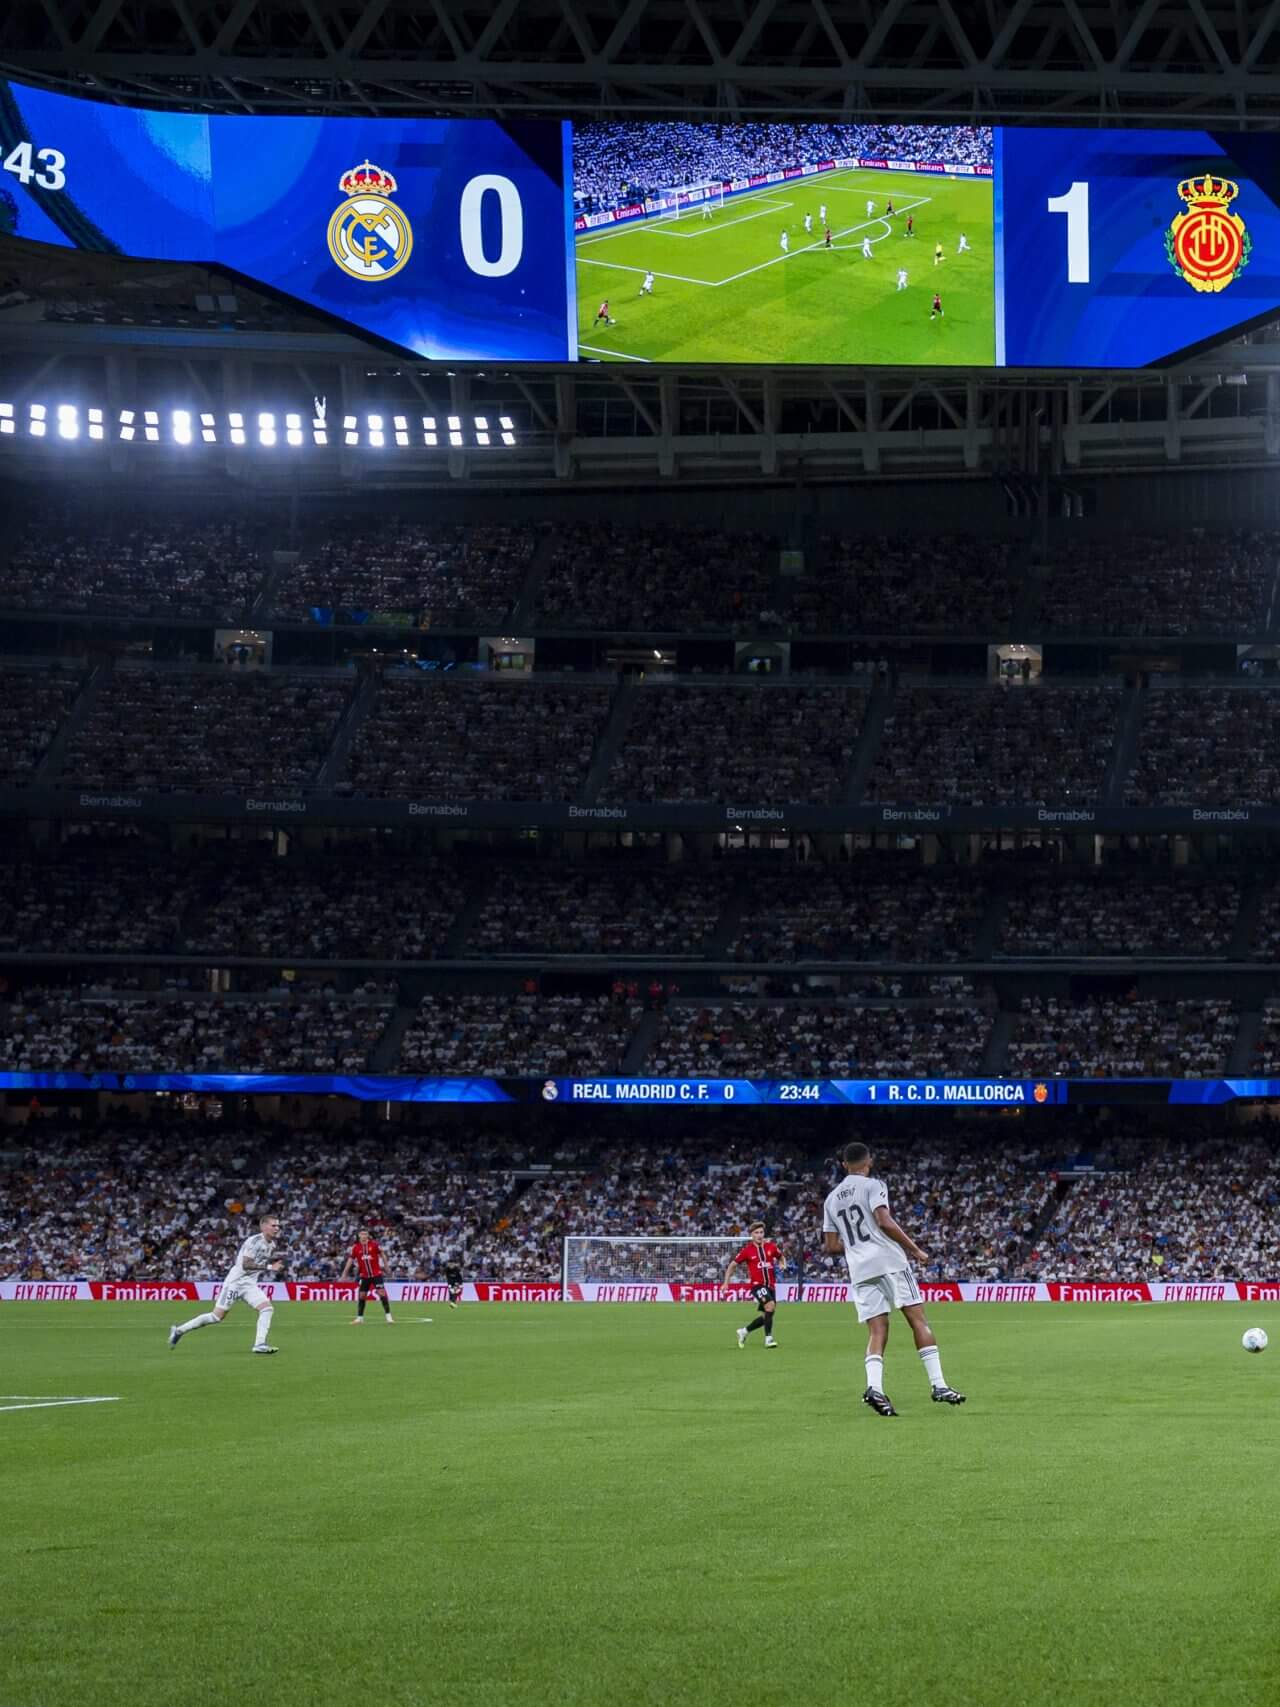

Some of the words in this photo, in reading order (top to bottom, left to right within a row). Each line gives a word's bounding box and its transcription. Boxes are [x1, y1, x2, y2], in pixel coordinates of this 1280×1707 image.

[0, 141, 66, 190] 43
[460, 174, 523, 278] 0
[1048, 181, 1090, 283] 1
[246, 799, 306, 811] Bernabéu
[408, 803, 467, 816] Bernabéu
[568, 806, 627, 818] Bernabéu
[726, 808, 784, 819] Bernabéu
[1038, 809, 1095, 820] Bernabéu
[1192, 808, 1249, 820] Bernabéu
[573, 1083, 611, 1099] REAL
[615, 1083, 675, 1099] MADRID
[680, 1084, 694, 1099] C.
[698, 1084, 709, 1099] F.
[724, 1084, 734, 1100] 0
[780, 1085, 820, 1100] 23:44
[868, 1085, 876, 1100] 1
[888, 1086, 903, 1100] R.
[907, 1085, 920, 1100] C.
[925, 1086, 939, 1100] D.
[944, 1085, 1024, 1100] MALLORCA
[837, 1204, 870, 1247] 12
[15, 1285, 33, 1300] FLY
[37, 1285, 77, 1300] BETTER
[102, 1284, 187, 1301] Emirates
[227, 1290, 239, 1300] 30
[296, 1284, 380, 1301] Emirats
[401, 1286, 420, 1301] FLY
[597, 1286, 615, 1301] FLY
[617, 1286, 658, 1301] BETTER
[807, 1287, 848, 1301] BETTER
[976, 1286, 994, 1301] FLY
[996, 1286, 1036, 1301] BETTER
[1060, 1285, 1142, 1301] Emirates
[1165, 1286, 1183, 1301] FLY
[1185, 1286, 1225, 1301] BETTER
